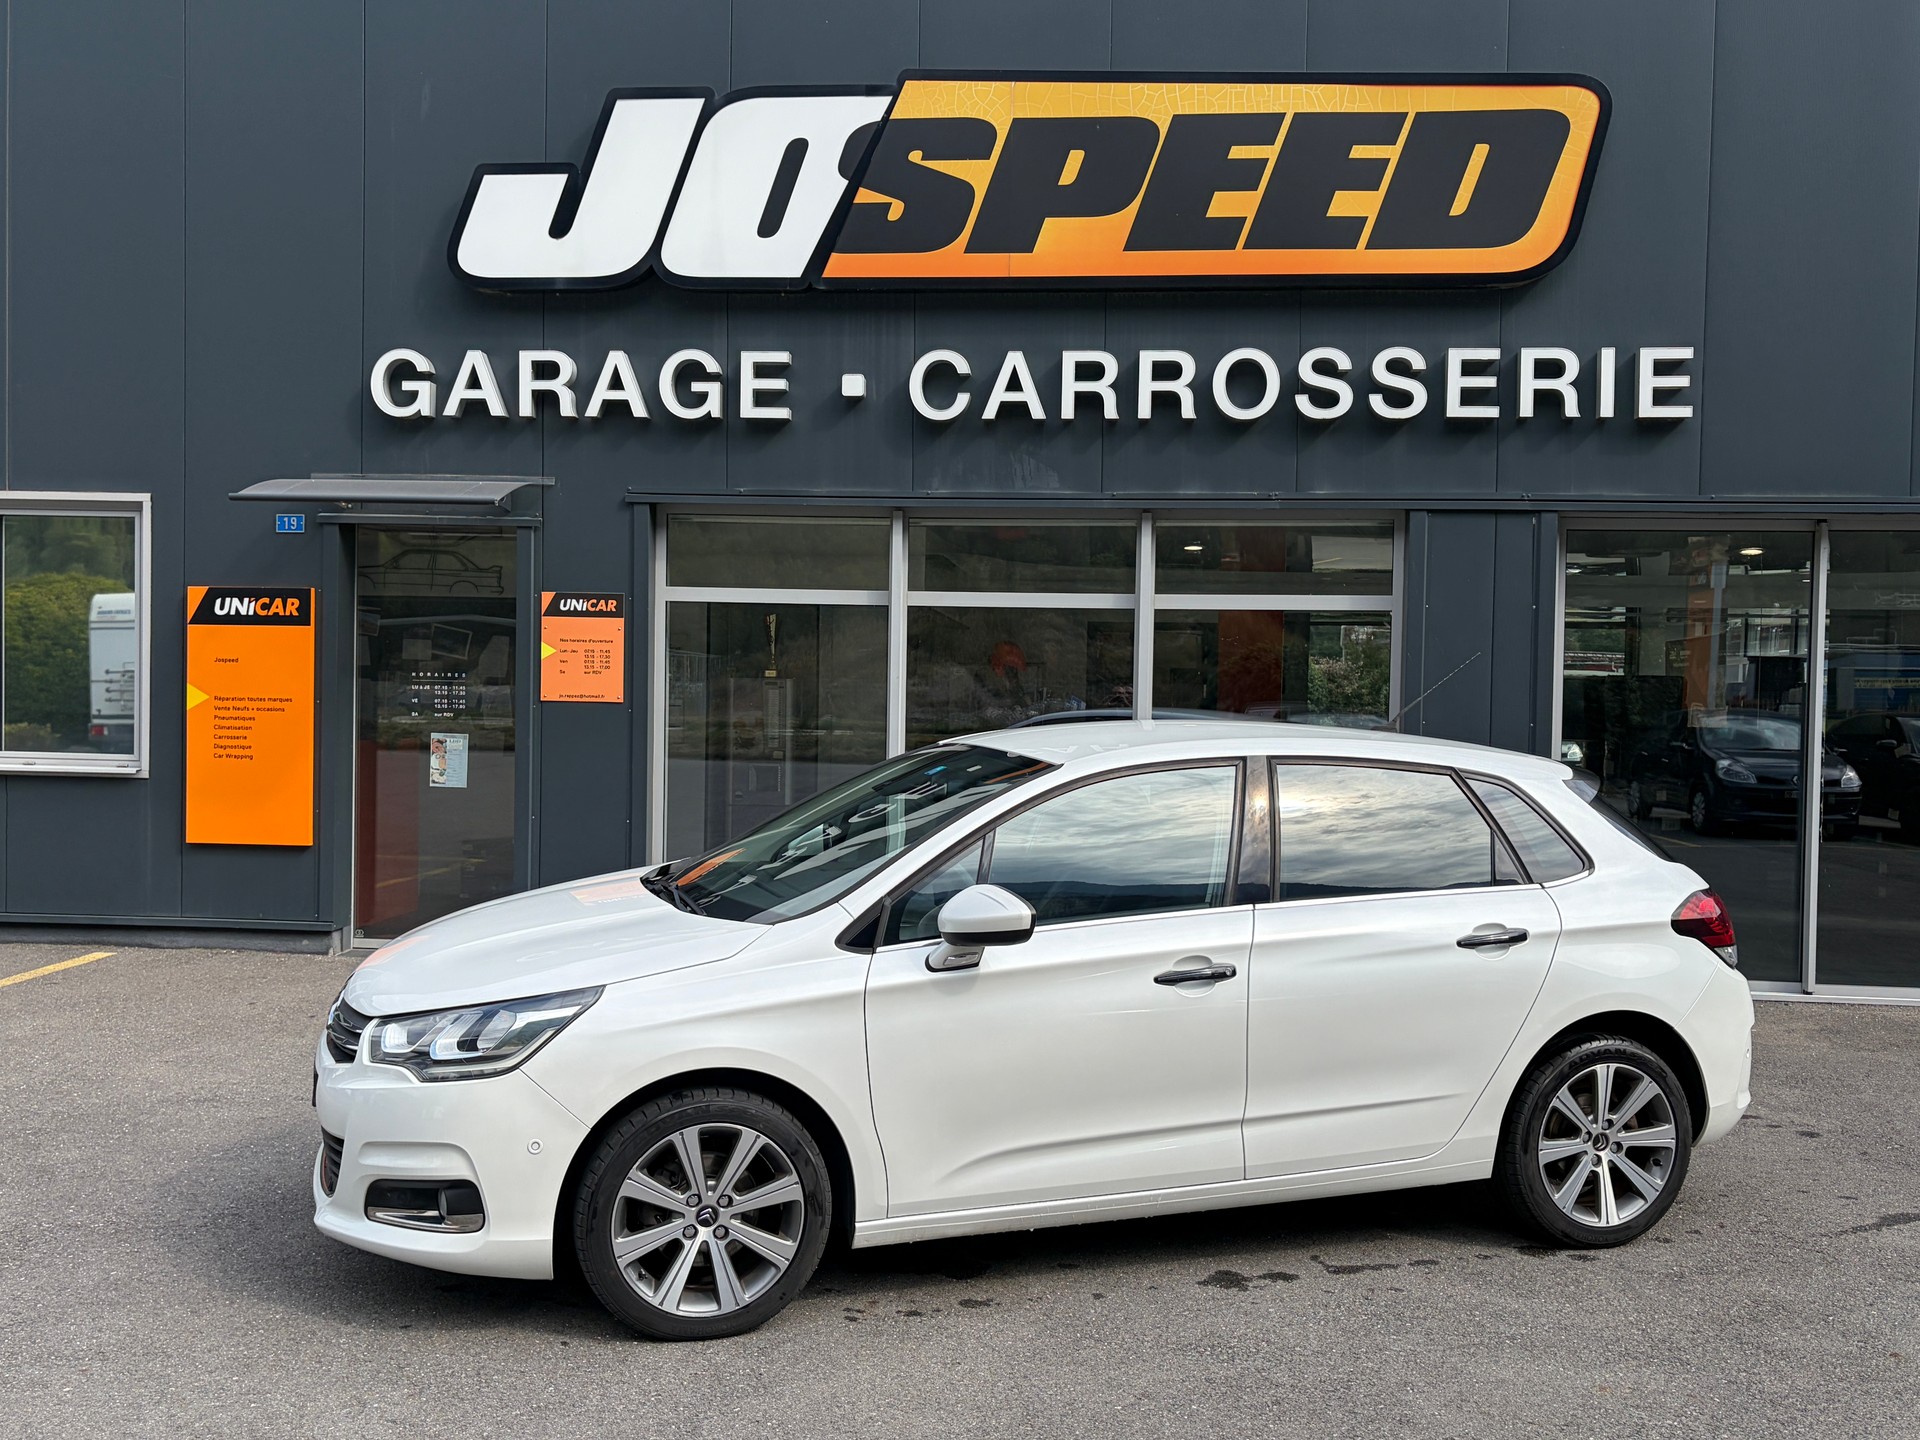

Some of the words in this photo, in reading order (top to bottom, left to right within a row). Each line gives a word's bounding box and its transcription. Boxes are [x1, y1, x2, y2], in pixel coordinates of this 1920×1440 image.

[370, 348, 793, 421] GARAGE
[908, 346, 1695, 421] CARROSSERIE
[283, 517, 297, 530] 19
[214, 695, 247, 703] Réparation
